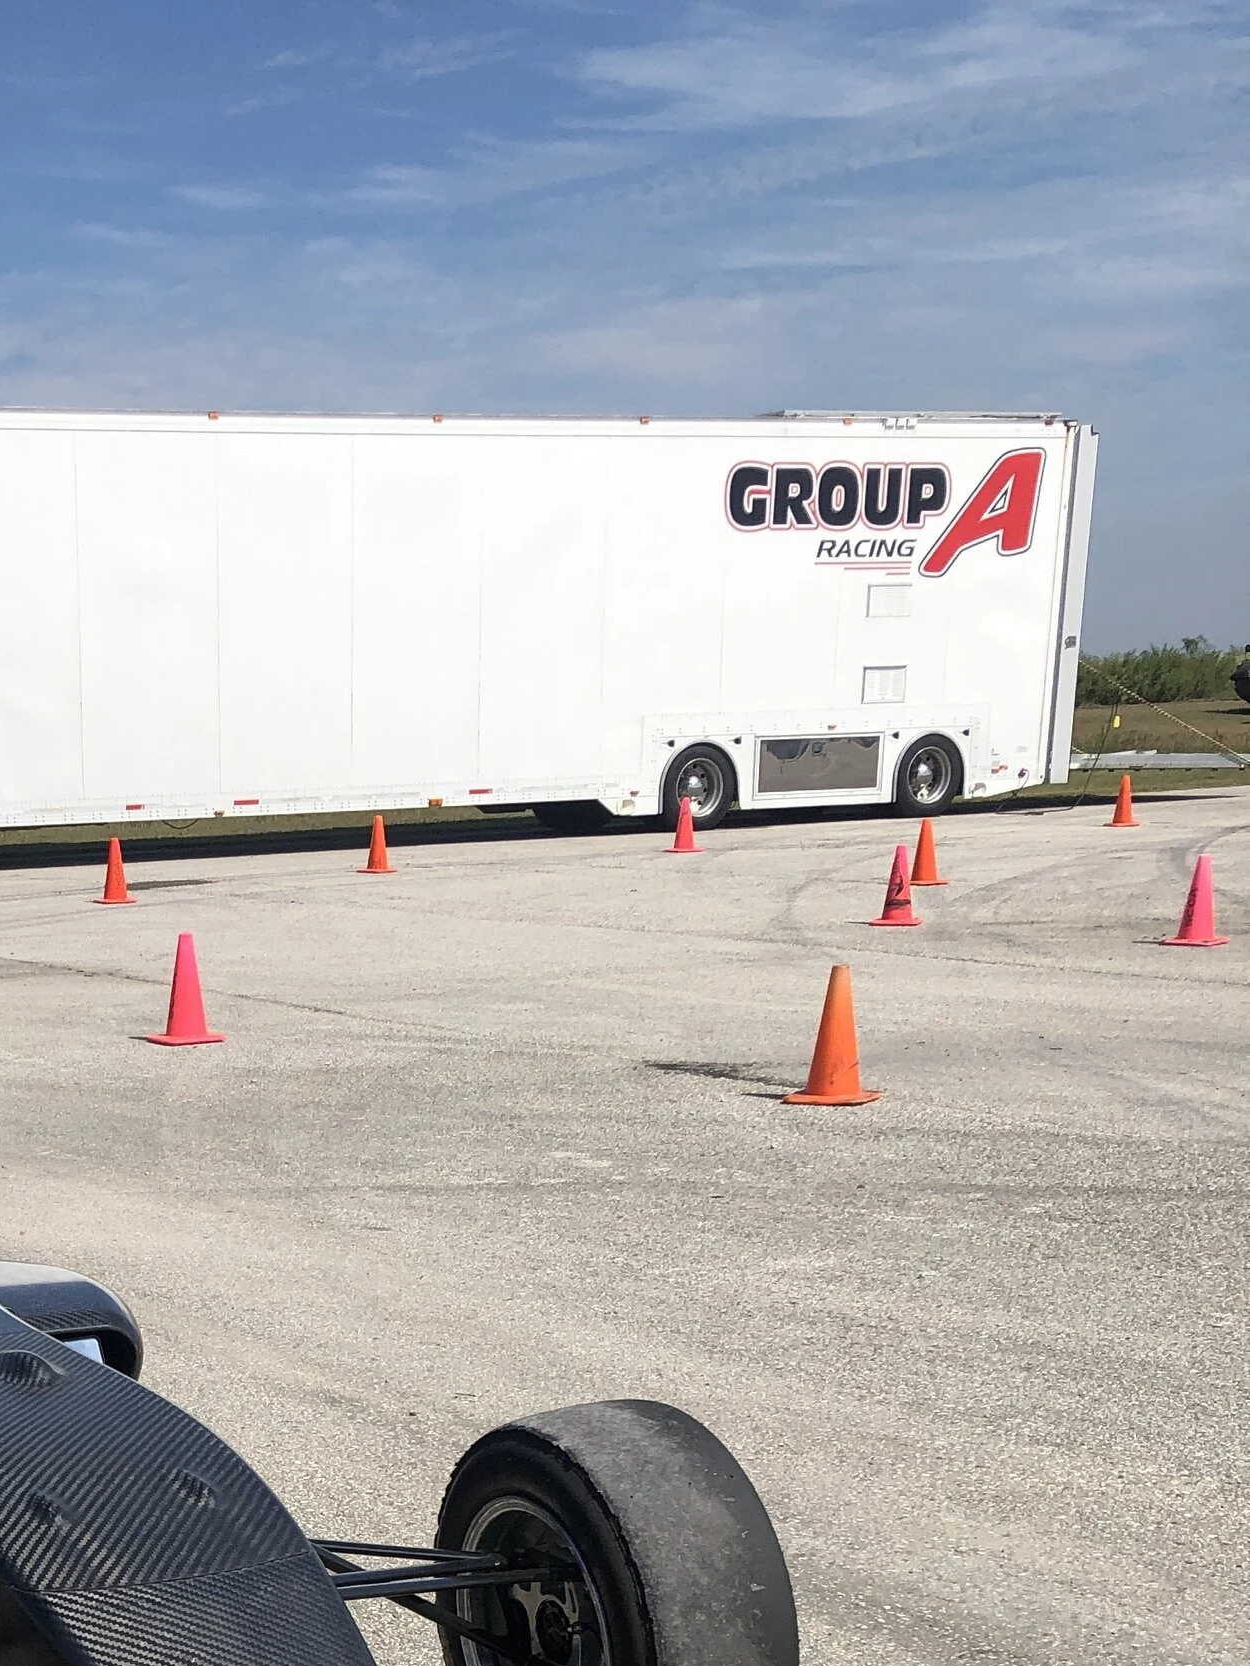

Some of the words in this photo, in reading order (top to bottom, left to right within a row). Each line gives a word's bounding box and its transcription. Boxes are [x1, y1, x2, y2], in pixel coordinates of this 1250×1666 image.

[726, 460, 950, 532] GROUP
[918, 447, 1046, 577] A
[816, 539, 917, 558] RACING
